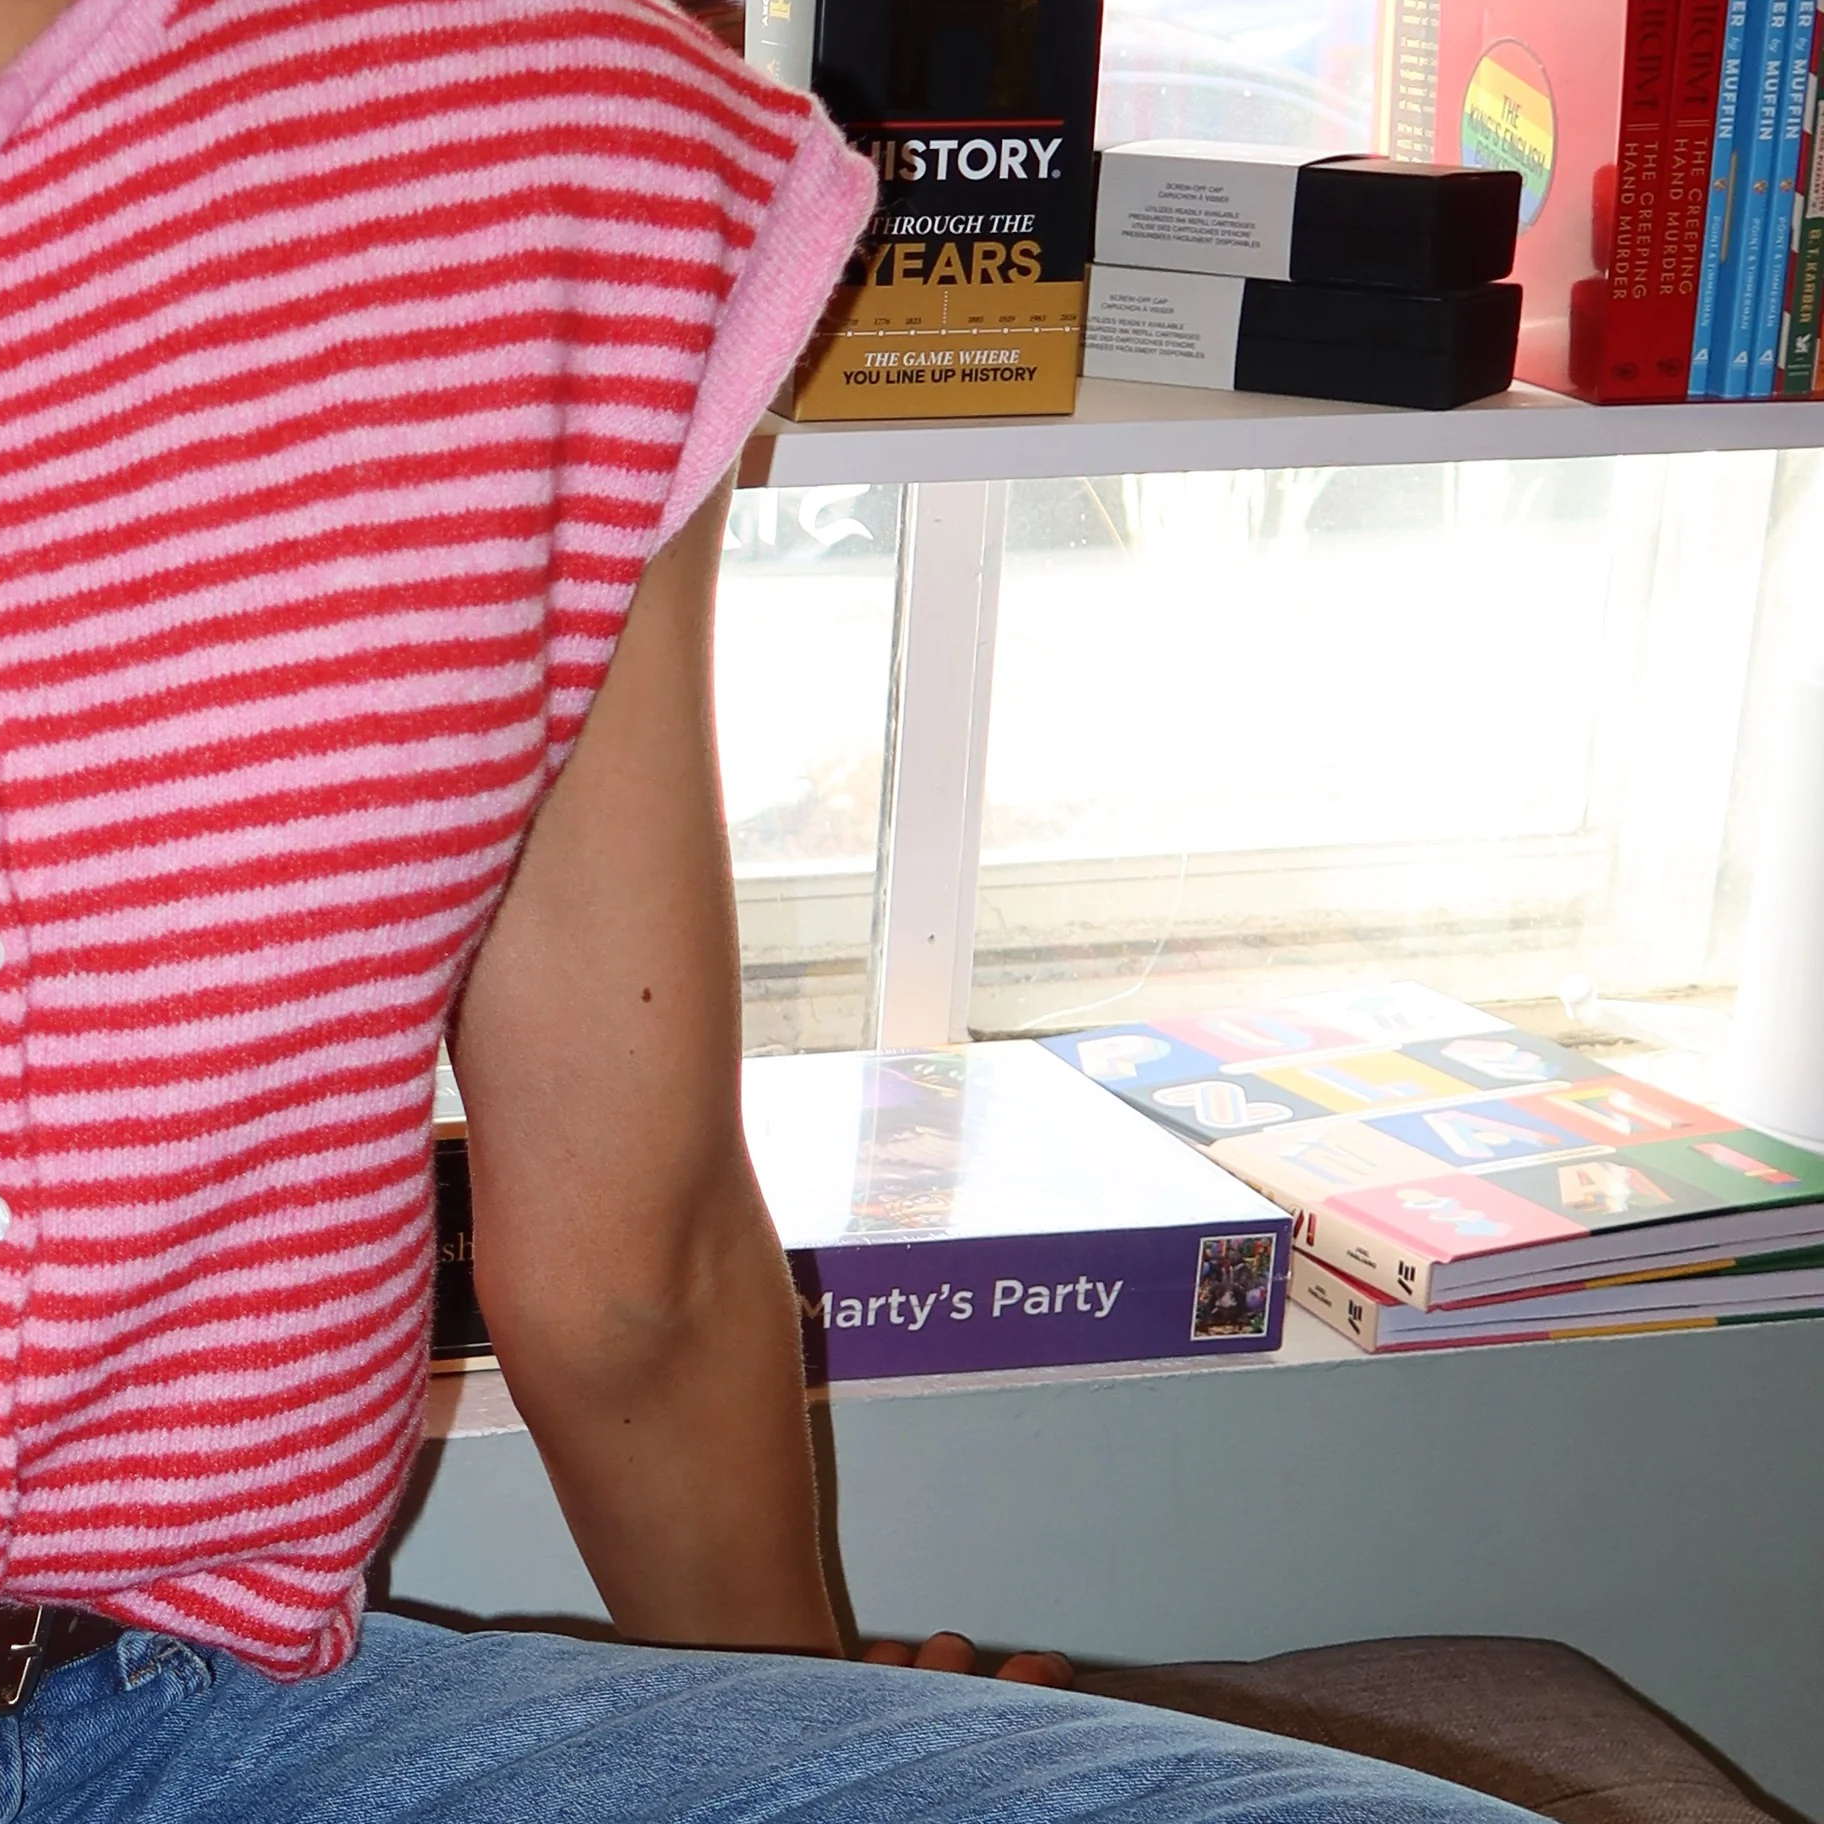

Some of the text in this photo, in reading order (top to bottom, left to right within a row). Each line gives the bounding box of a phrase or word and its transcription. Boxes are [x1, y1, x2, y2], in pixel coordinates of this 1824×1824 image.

[1501, 93, 1522, 131] THE
[1717, 59, 1739, 140] MUFFIN
[870, 213, 1036, 236] THROUGH THE
[1613, 142, 1638, 300] HAND MURDER
[1632, 142, 1659, 300] THE CREEPING
[866, 239, 1043, 288] YEARS
[1799, 262, 1819, 324] KARBER
[843, 366, 1038, 386] YOU LINE UP HISTORY
[864, 348, 1020, 367] THE GAME WHERE
[798, 1274, 1124, 1332] Marty's Party
